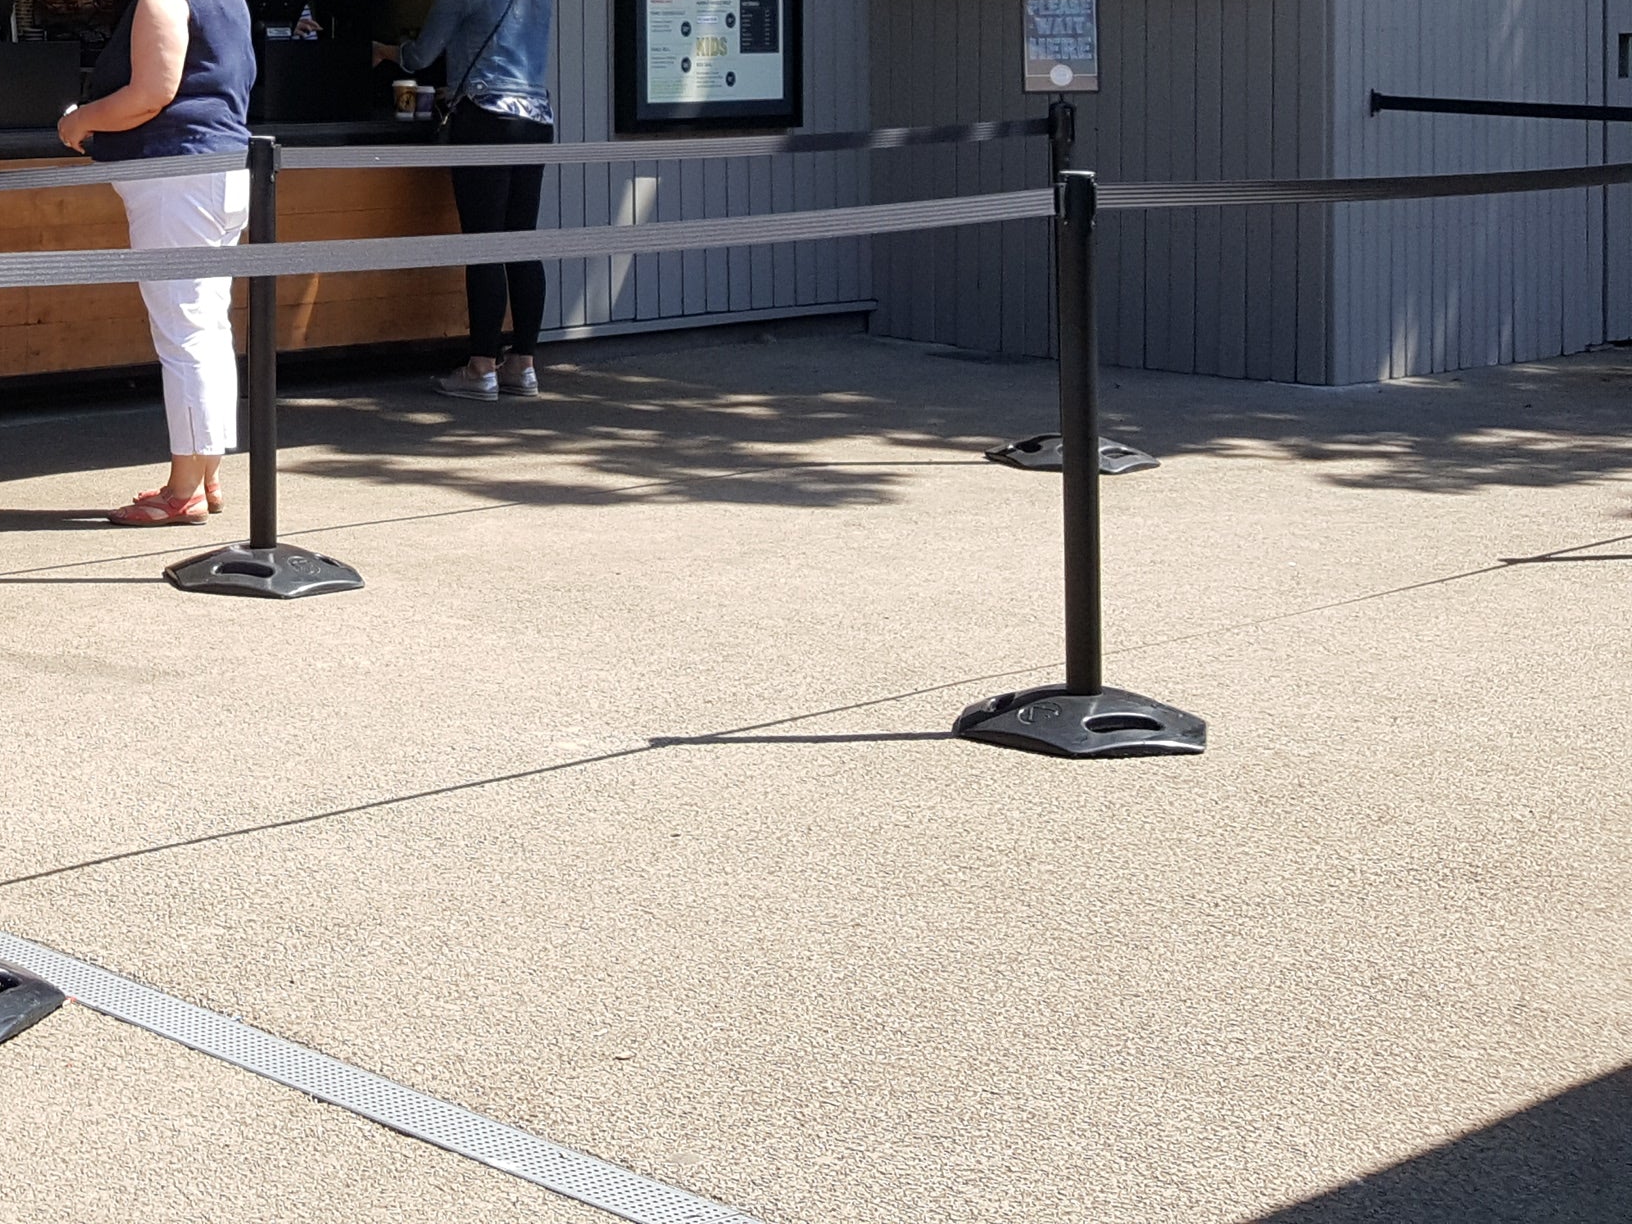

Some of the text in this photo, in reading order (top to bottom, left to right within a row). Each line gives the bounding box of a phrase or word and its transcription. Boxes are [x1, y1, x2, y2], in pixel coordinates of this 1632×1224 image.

[1034, 16, 1085, 35] WAIT
[695, 36, 728, 58] KIDS
[1028, 36, 1093, 61] HERE
